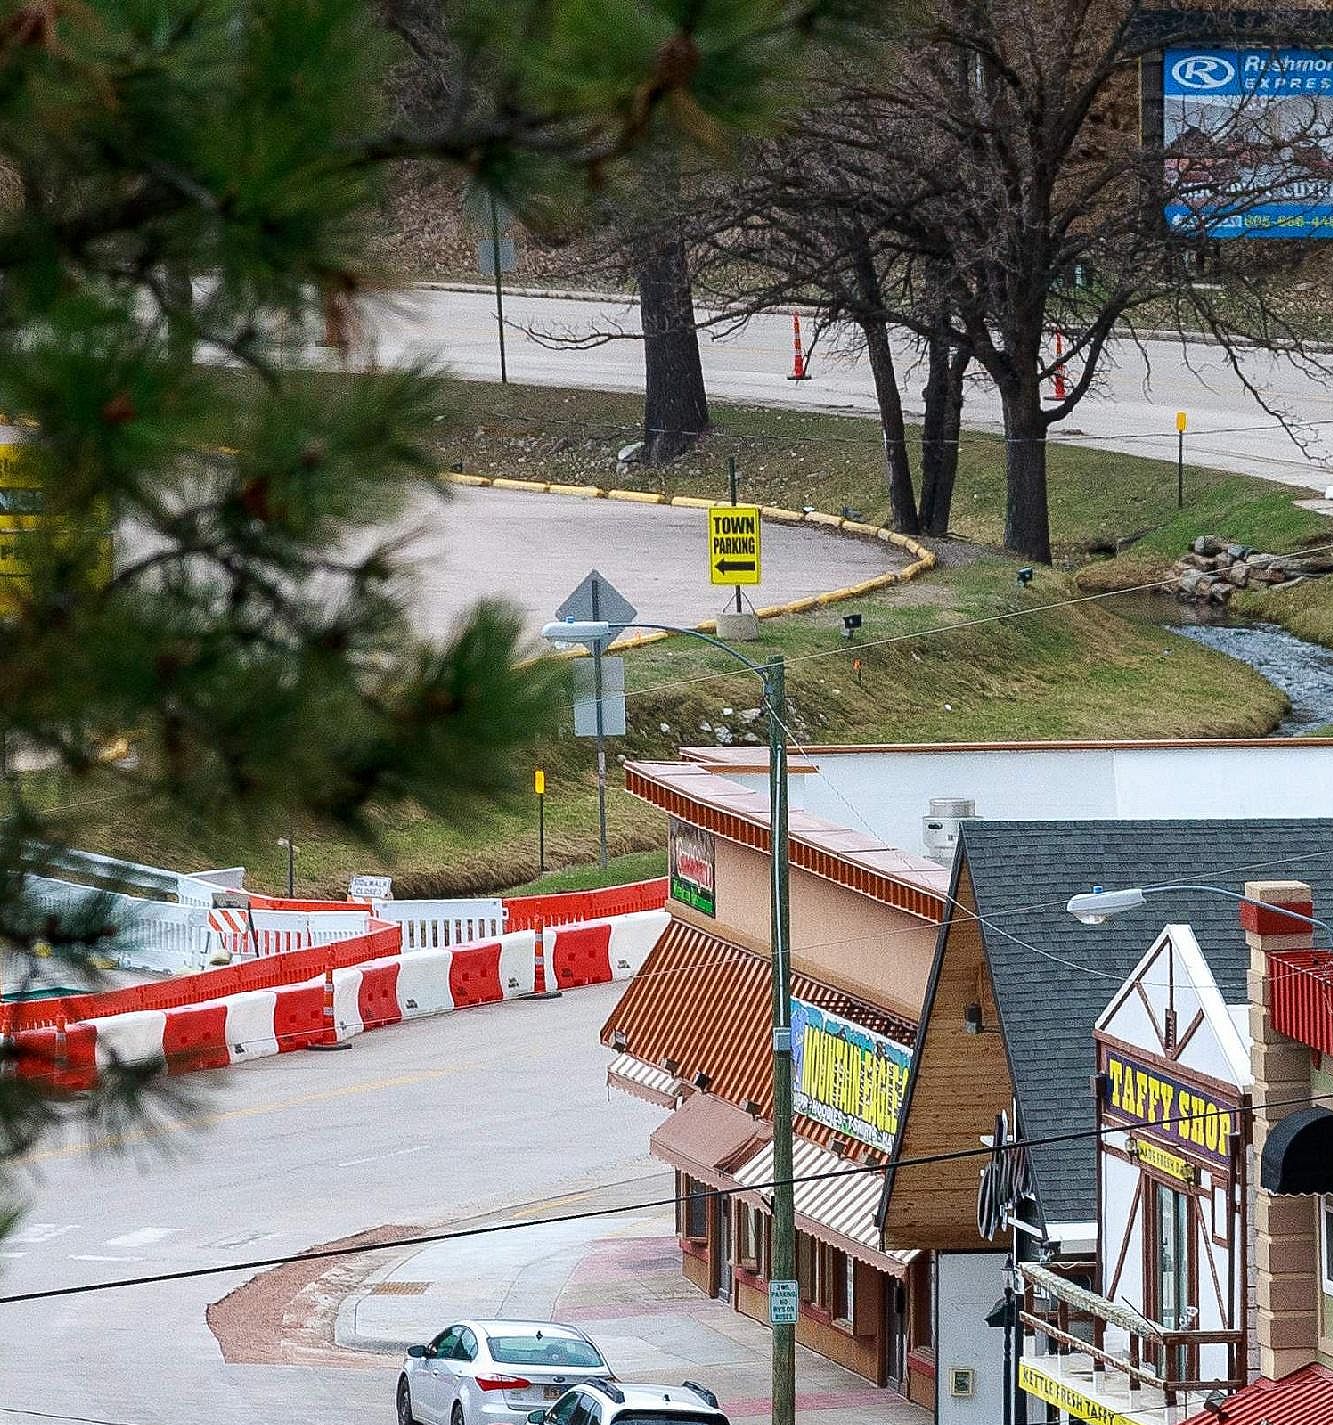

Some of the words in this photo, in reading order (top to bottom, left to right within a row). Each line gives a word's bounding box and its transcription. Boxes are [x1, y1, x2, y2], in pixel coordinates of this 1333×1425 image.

[713, 516, 755, 535] TOWN
[713, 536, 755, 555] PARKING
[1109, 1058, 1174, 1132] TAFFY
[1178, 1090, 1231, 1157] SHOP
[1023, 1366, 1054, 1397] KETTLE
[1056, 1381, 1083, 1413] FRESH
